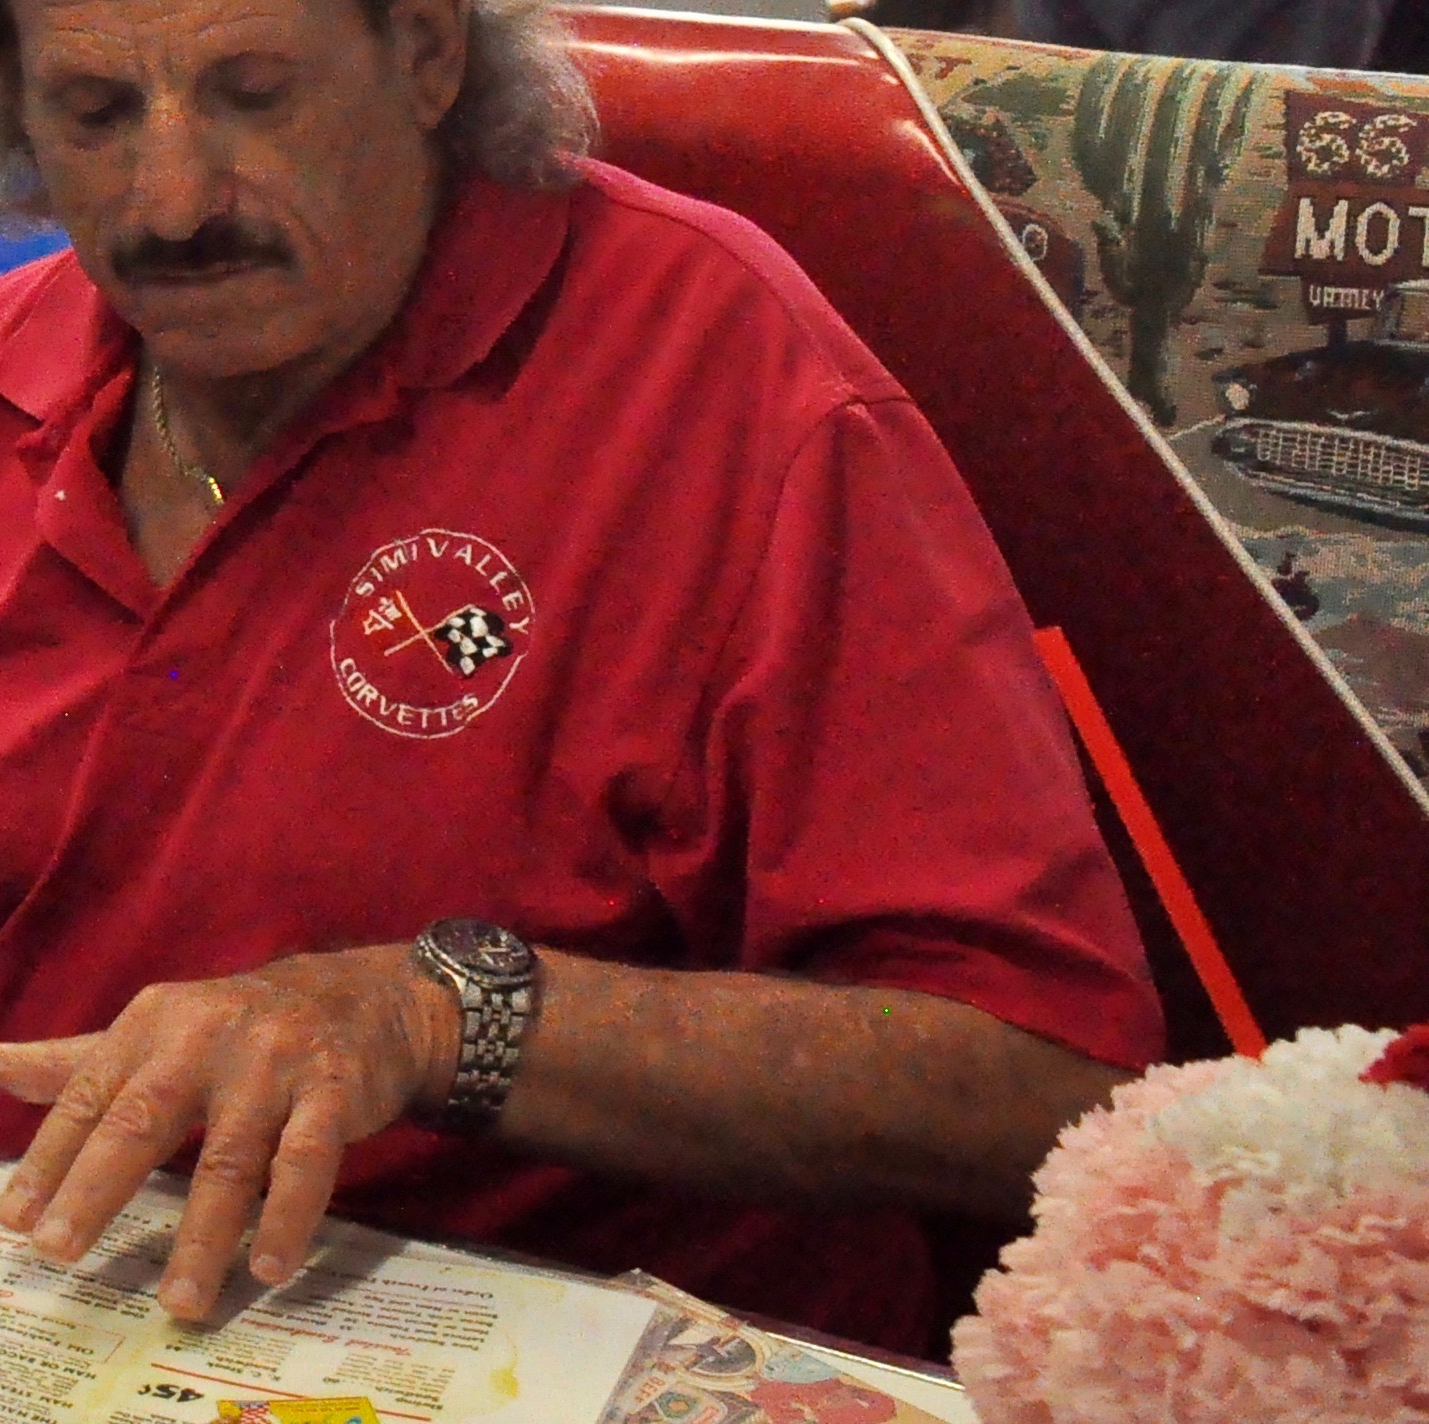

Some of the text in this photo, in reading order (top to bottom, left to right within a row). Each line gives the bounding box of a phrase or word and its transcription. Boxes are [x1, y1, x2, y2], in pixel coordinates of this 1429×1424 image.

[1296, 110, 1417, 177] 66
[354, 537, 530, 635] SIMI VALLEY
[339, 657, 479, 729] CORVETTES
